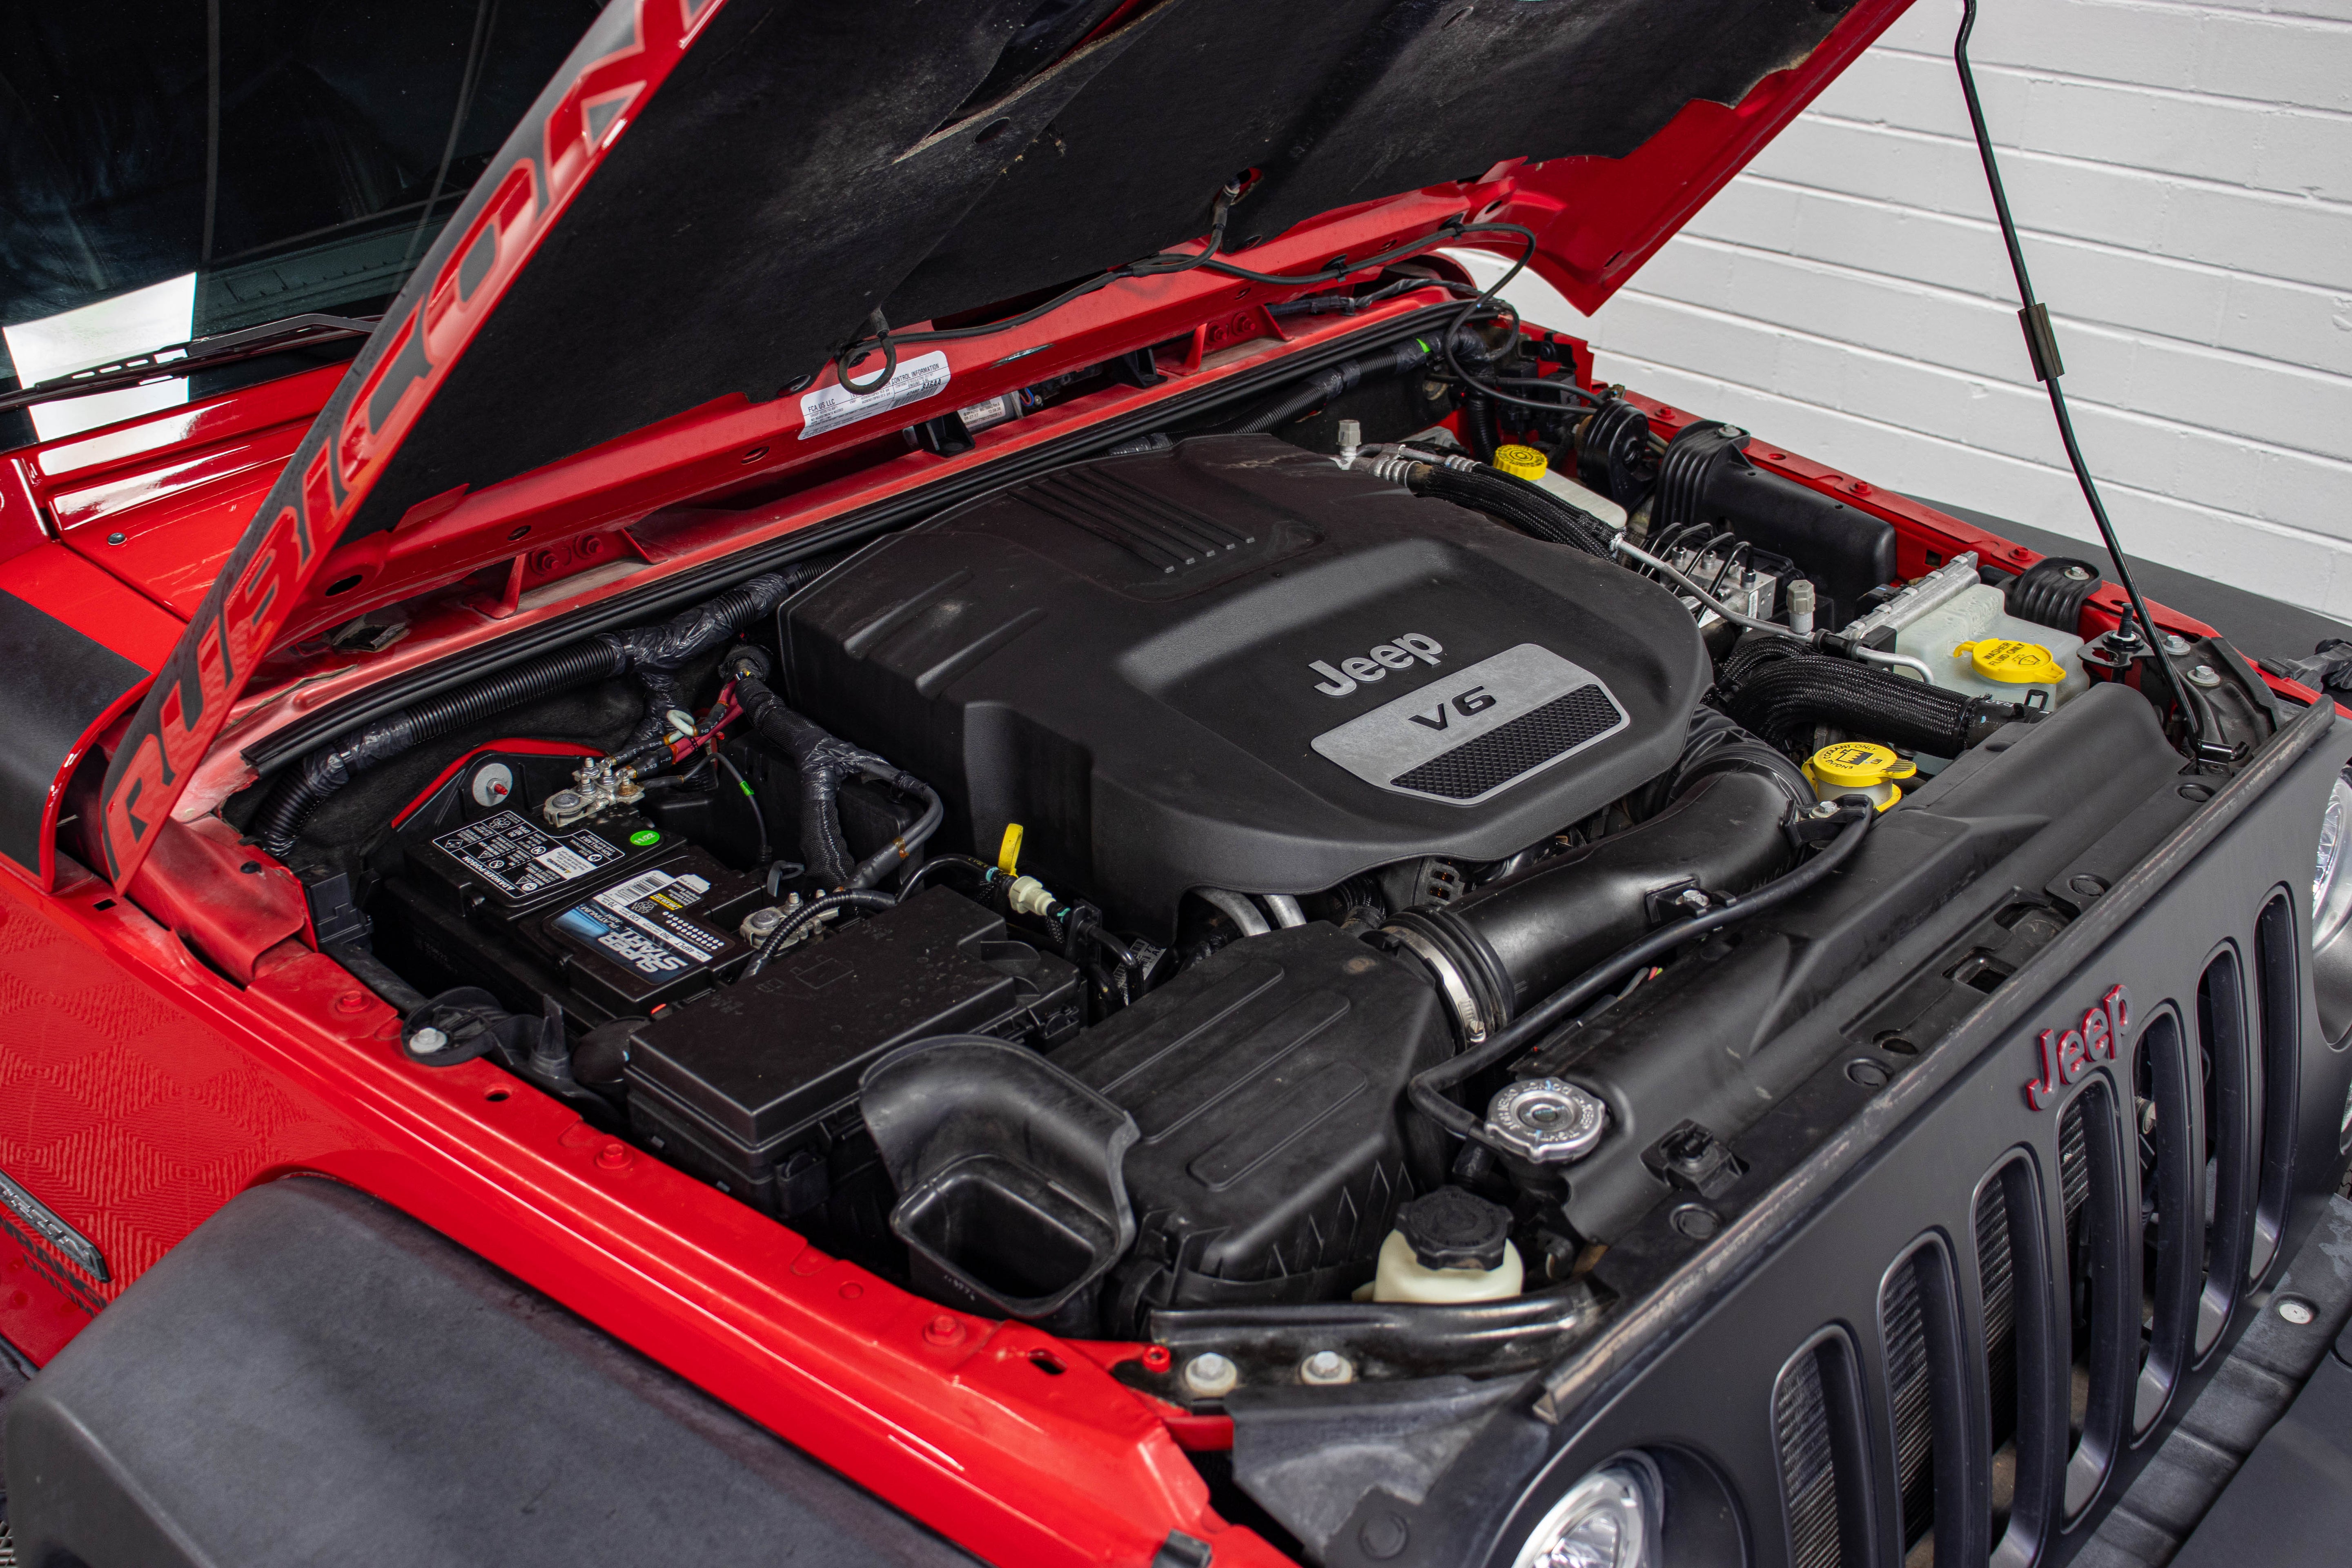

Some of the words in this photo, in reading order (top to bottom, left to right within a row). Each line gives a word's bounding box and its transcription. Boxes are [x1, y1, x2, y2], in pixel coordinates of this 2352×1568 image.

[891, 373, 911, 385] CONTROL
[911, 363, 939, 378] INFORMATION
[920, 378, 942, 391] 846AA
[808, 404, 817, 413] FCA
[818, 401, 825, 410] US
[104, 0, 723, 878] RUBICON
[1984, 642, 2012, 659] WASHER
[1989, 654, 2009, 666] FLUID
[2007, 643, 2025, 654] ONLY
[1308, 633, 1443, 698] Jeep
[1408, 684, 1496, 731] V6
[1823, 744, 1851, 759] COOLANT
[1825, 759, 1853, 769] ENGINE
[579, 835, 613, 857] NON-SPILLABLE
[633, 833, 656, 844] 11/22
[461, 855, 511, 887] DANGER/POISON
[579, 906, 620, 929] PLATINUM
[605, 913, 623, 923] AGM
[628, 913, 642, 922] 120
[659, 931, 673, 940] 760
[674, 940, 696, 953] 48PLT
[598, 932, 659, 972] SUPER
[610, 928, 689, 971] START
[2025, 984, 2134, 1111] Jeep
